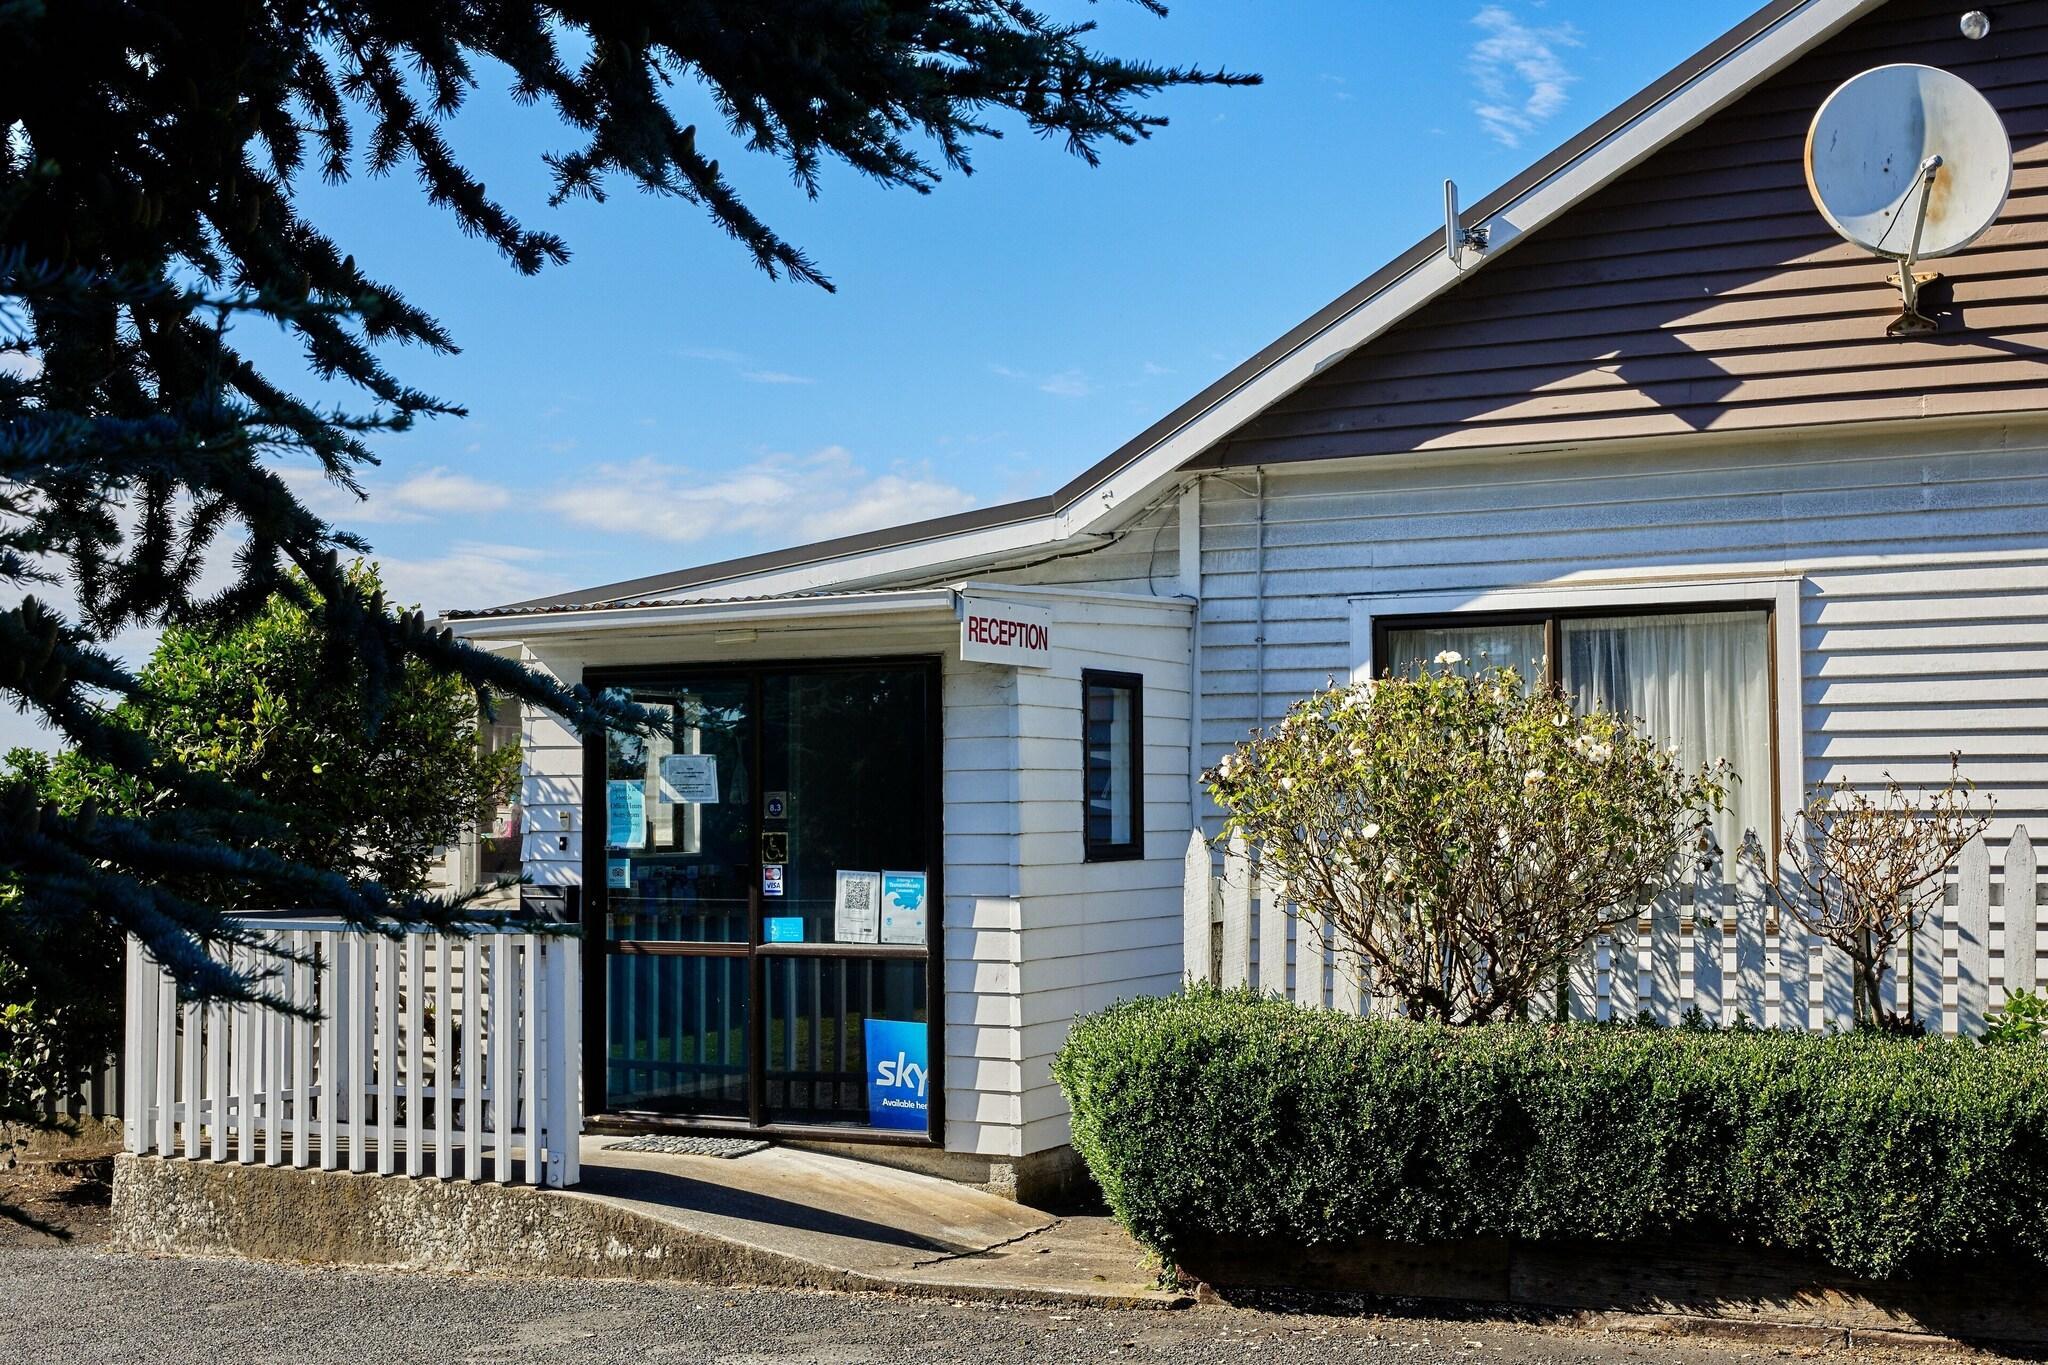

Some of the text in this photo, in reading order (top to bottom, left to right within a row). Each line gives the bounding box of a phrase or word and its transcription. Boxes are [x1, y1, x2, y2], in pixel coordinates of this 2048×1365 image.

[968, 615, 1048, 651] RECEPTION
[769, 804, 782, 812] 8.3
[876, 1052, 928, 1096] sky
[882, 1098, 915, 1109] Available
